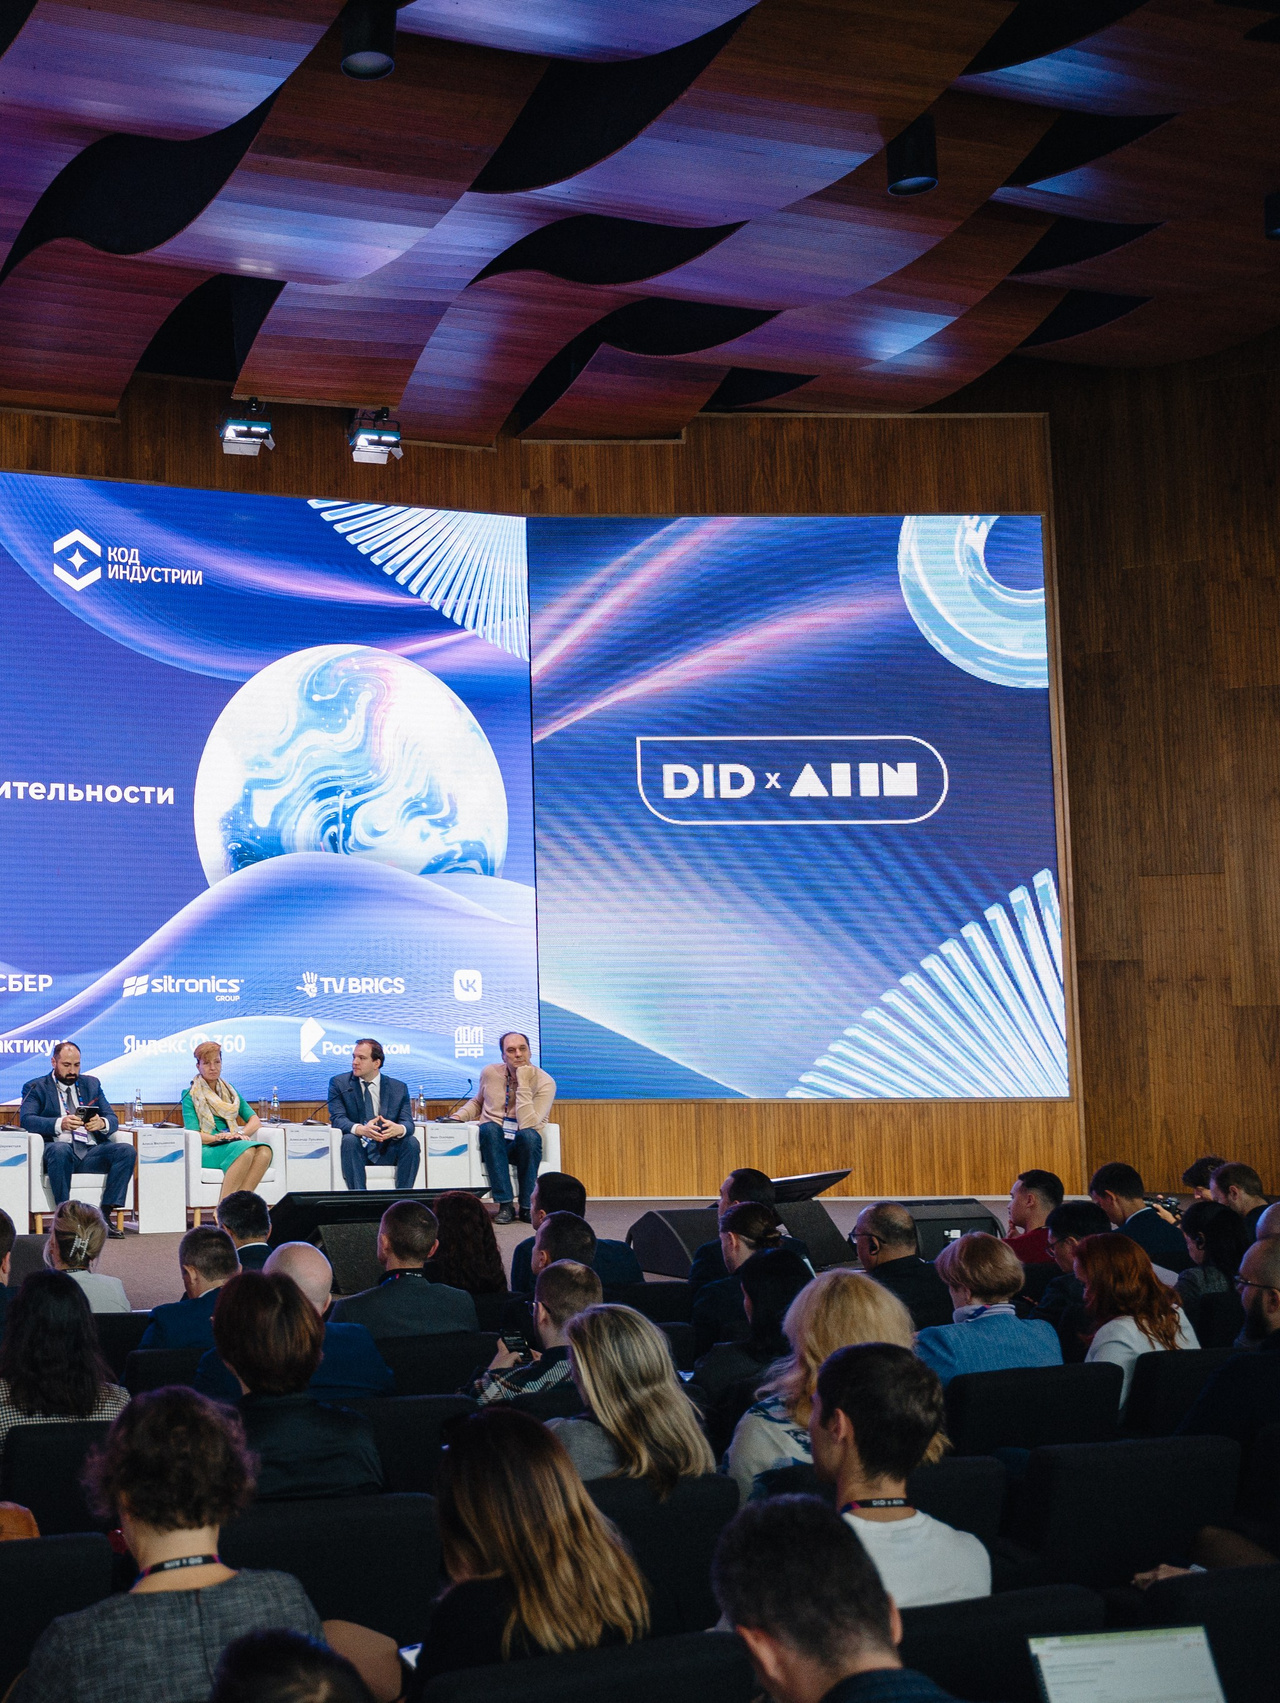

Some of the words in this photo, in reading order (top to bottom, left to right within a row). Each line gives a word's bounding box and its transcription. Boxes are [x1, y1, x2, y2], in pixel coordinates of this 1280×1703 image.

[107, 546, 141, 566] КОД
[107, 565, 203, 586] ИНДУСТРИИ
[662, 763, 756, 799] DID
[150, 974, 241, 994] sitronics
[319, 976, 346, 994] TV
[347, 976, 406, 995] BRICS
[123, 1034, 187, 1056] Яндекс
